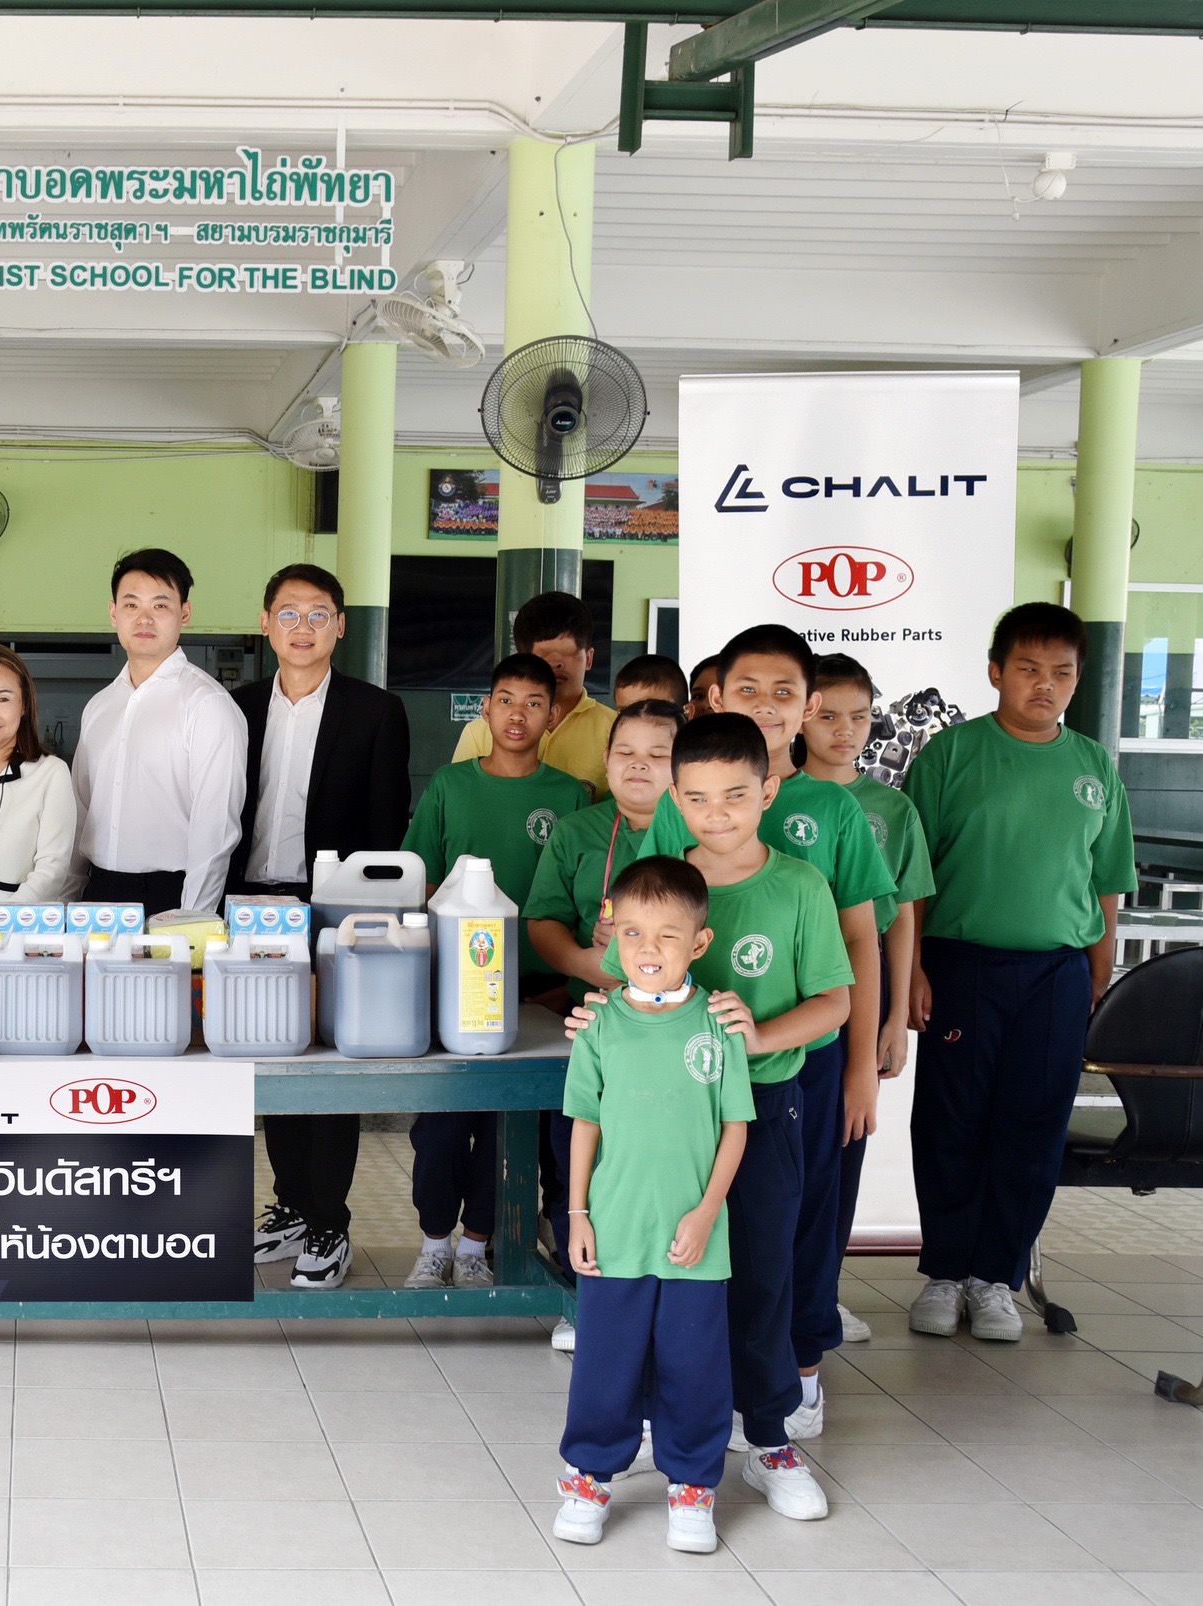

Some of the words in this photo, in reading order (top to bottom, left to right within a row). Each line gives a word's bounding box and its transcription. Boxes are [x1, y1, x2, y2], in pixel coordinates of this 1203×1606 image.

[197, 218, 393, 254] สยามบรมราชกุมารี
[50, 265, 170, 288] SCHOOL
[178, 266, 236, 288] FOR
[244, 267, 298, 289] THE
[311, 268, 397, 291] BLIND
[782, 475, 988, 499] CHALIT
[798, 553, 886, 597] POP
[841, 628, 896, 642] Rubber
[902, 628, 943, 641] Parts
[68, 1083, 136, 1115] POP
